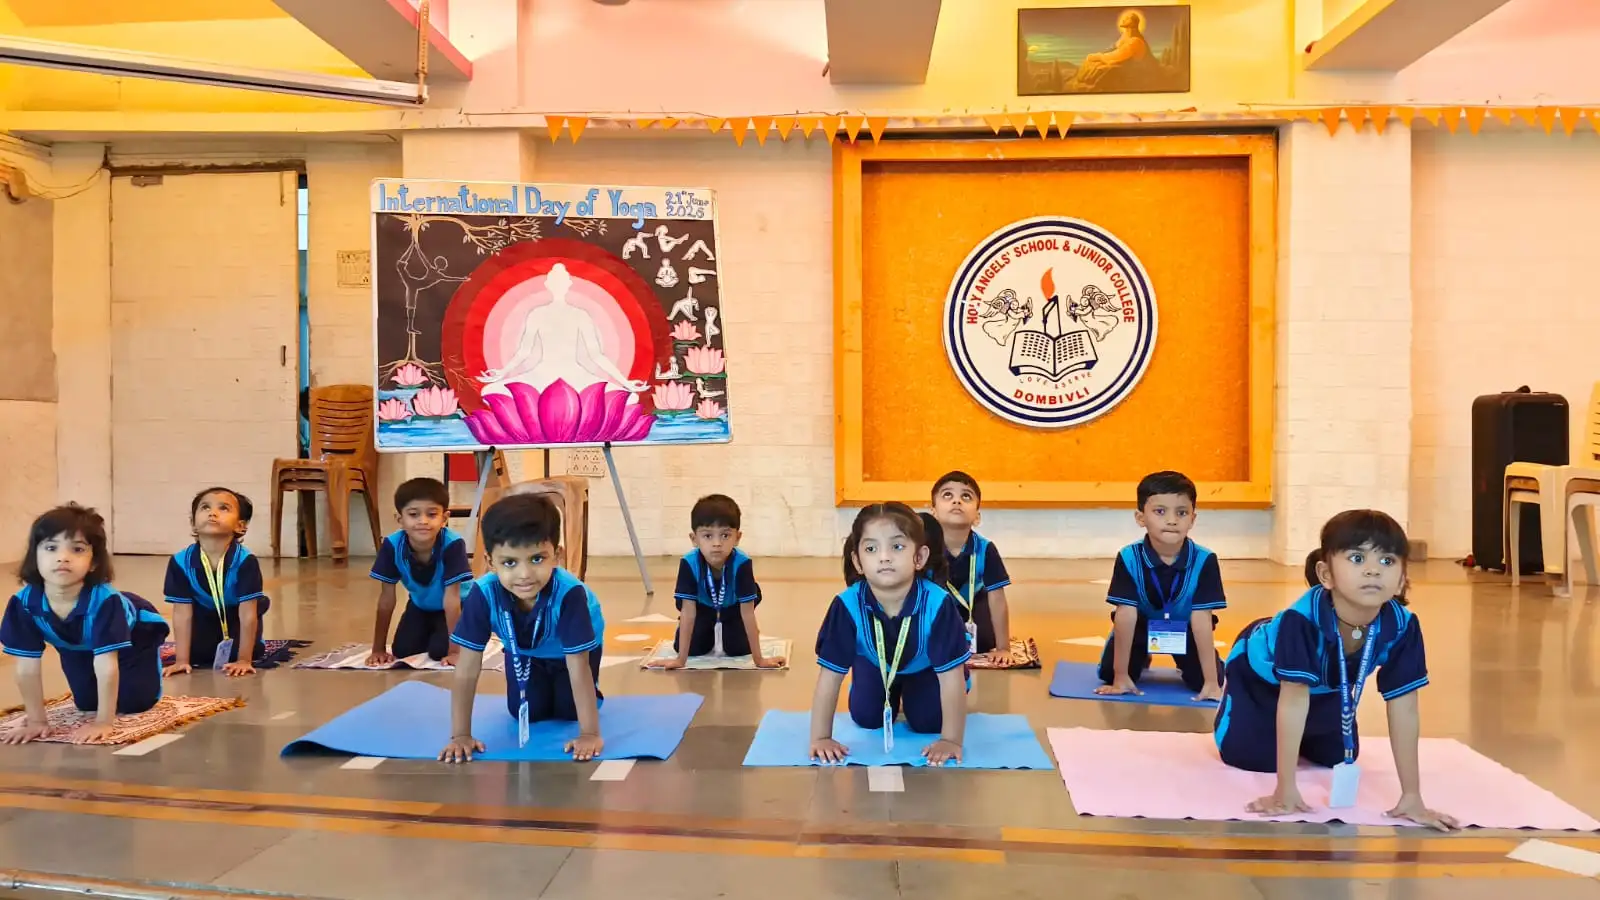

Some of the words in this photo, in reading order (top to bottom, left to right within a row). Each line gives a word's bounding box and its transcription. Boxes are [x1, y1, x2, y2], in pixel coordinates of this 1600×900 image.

[379, 183, 518, 214] International
[524, 186, 572, 227] Day
[576, 188, 600, 217] of
[607, 189, 658, 229] Yoga
[1013, 239, 1059, 258] SCHOOL
[1062, 240, 1071, 250] &
[1073, 243, 1114, 275] JUNIOR
[1110, 272, 1136, 323] COLLEGE
[1013, 387, 1090, 405] DOMBIVLI
[1019, 376, 1047, 386] LOVE
